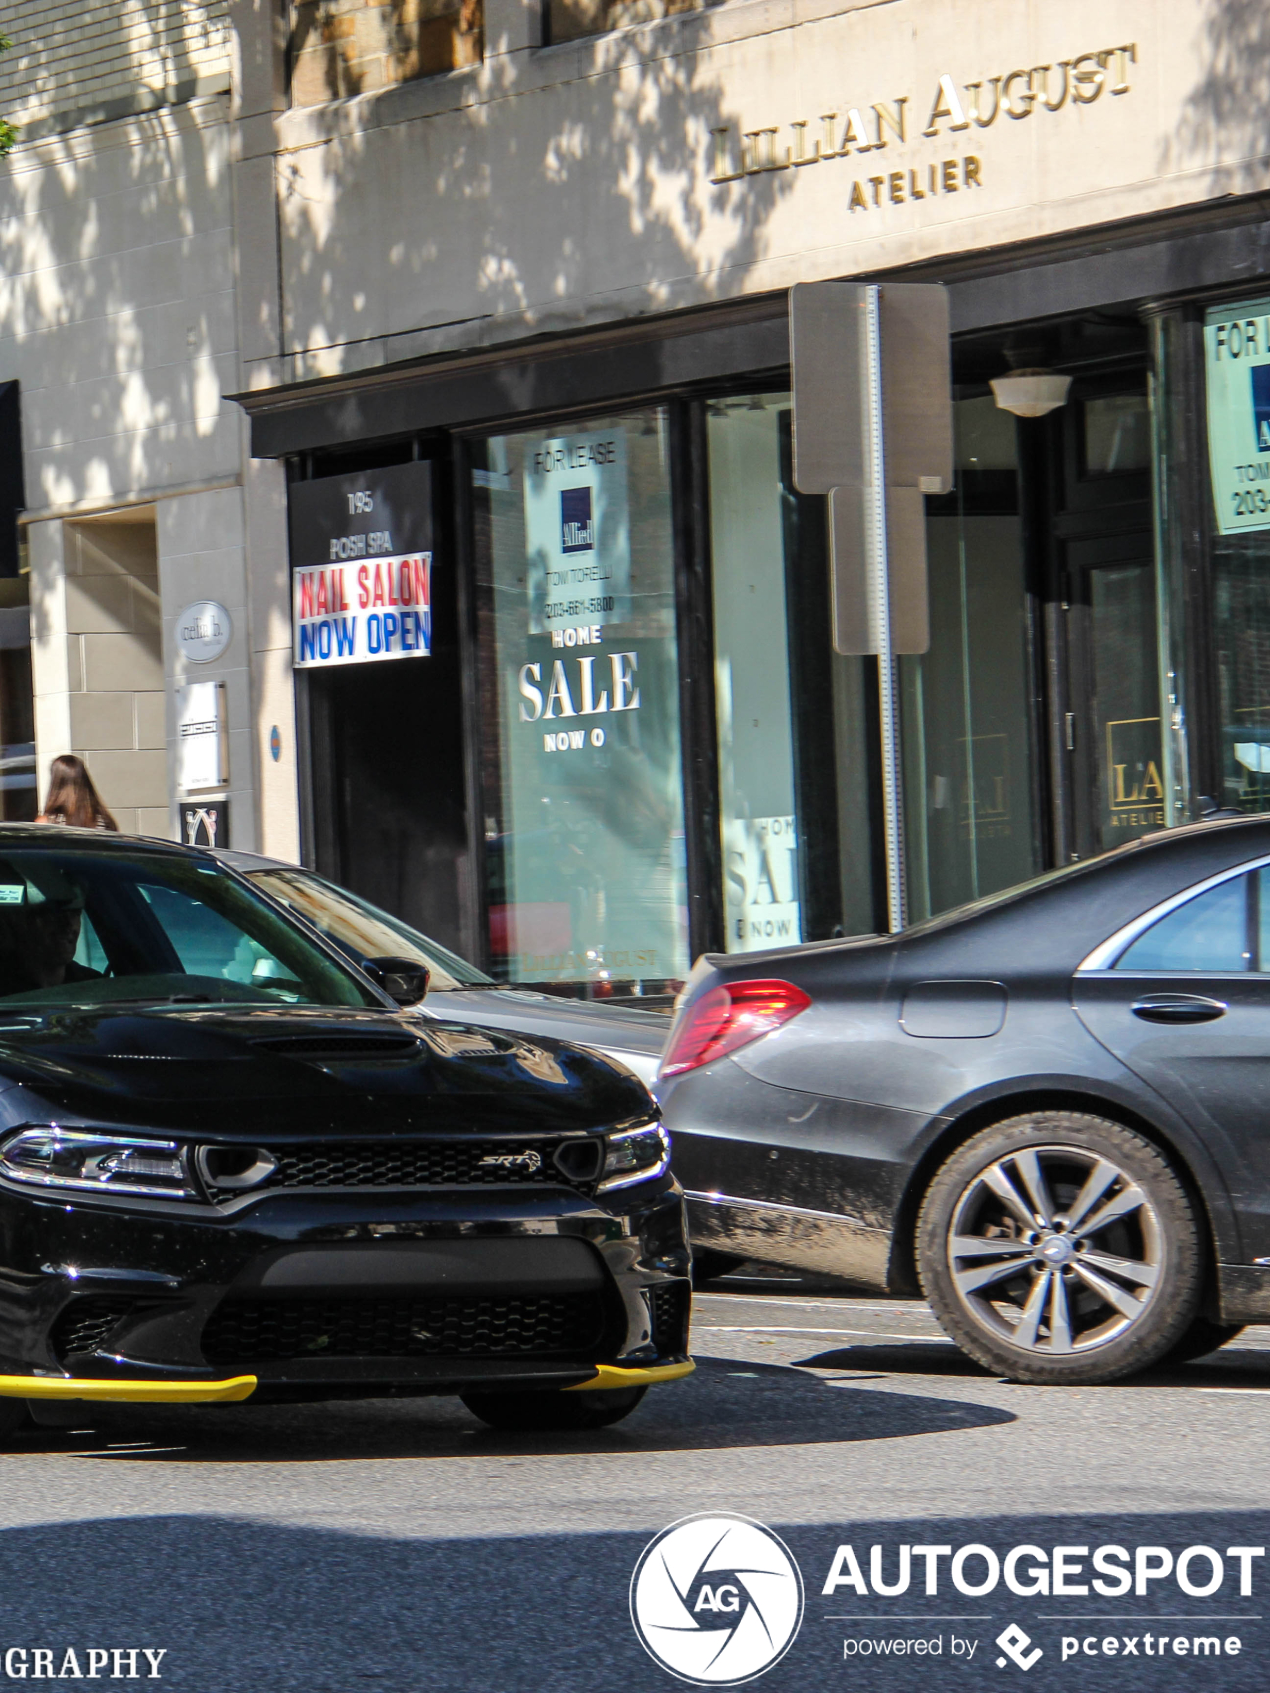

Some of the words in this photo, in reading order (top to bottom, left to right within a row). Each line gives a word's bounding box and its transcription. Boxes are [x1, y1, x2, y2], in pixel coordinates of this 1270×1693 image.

[710, 96, 909, 184] LILLIAN
[923, 43, 1137, 137] AUGUST
[847, 155, 983, 212] ATELIER
[1215, 320, 1259, 361] FOR
[534, 450, 565, 475] FOR
[569, 441, 616, 469] LEASE
[347, 491, 374, 515] 195
[330, 534, 366, 560] POSH
[367, 530, 393, 554] SPA
[300, 568, 350, 619] NAIL
[358, 558, 429, 609] SALON
[300, 616, 357, 662] NOW
[367, 611, 431, 655] OPEN
[552, 625, 602, 648] HOME
[518, 652, 641, 722] SALE
[544, 731, 586, 752] NOW
[1113, 761, 1164, 802] LA
[750, 919, 791, 938] NOW
[478, 1155, 529, 1167] SRT
